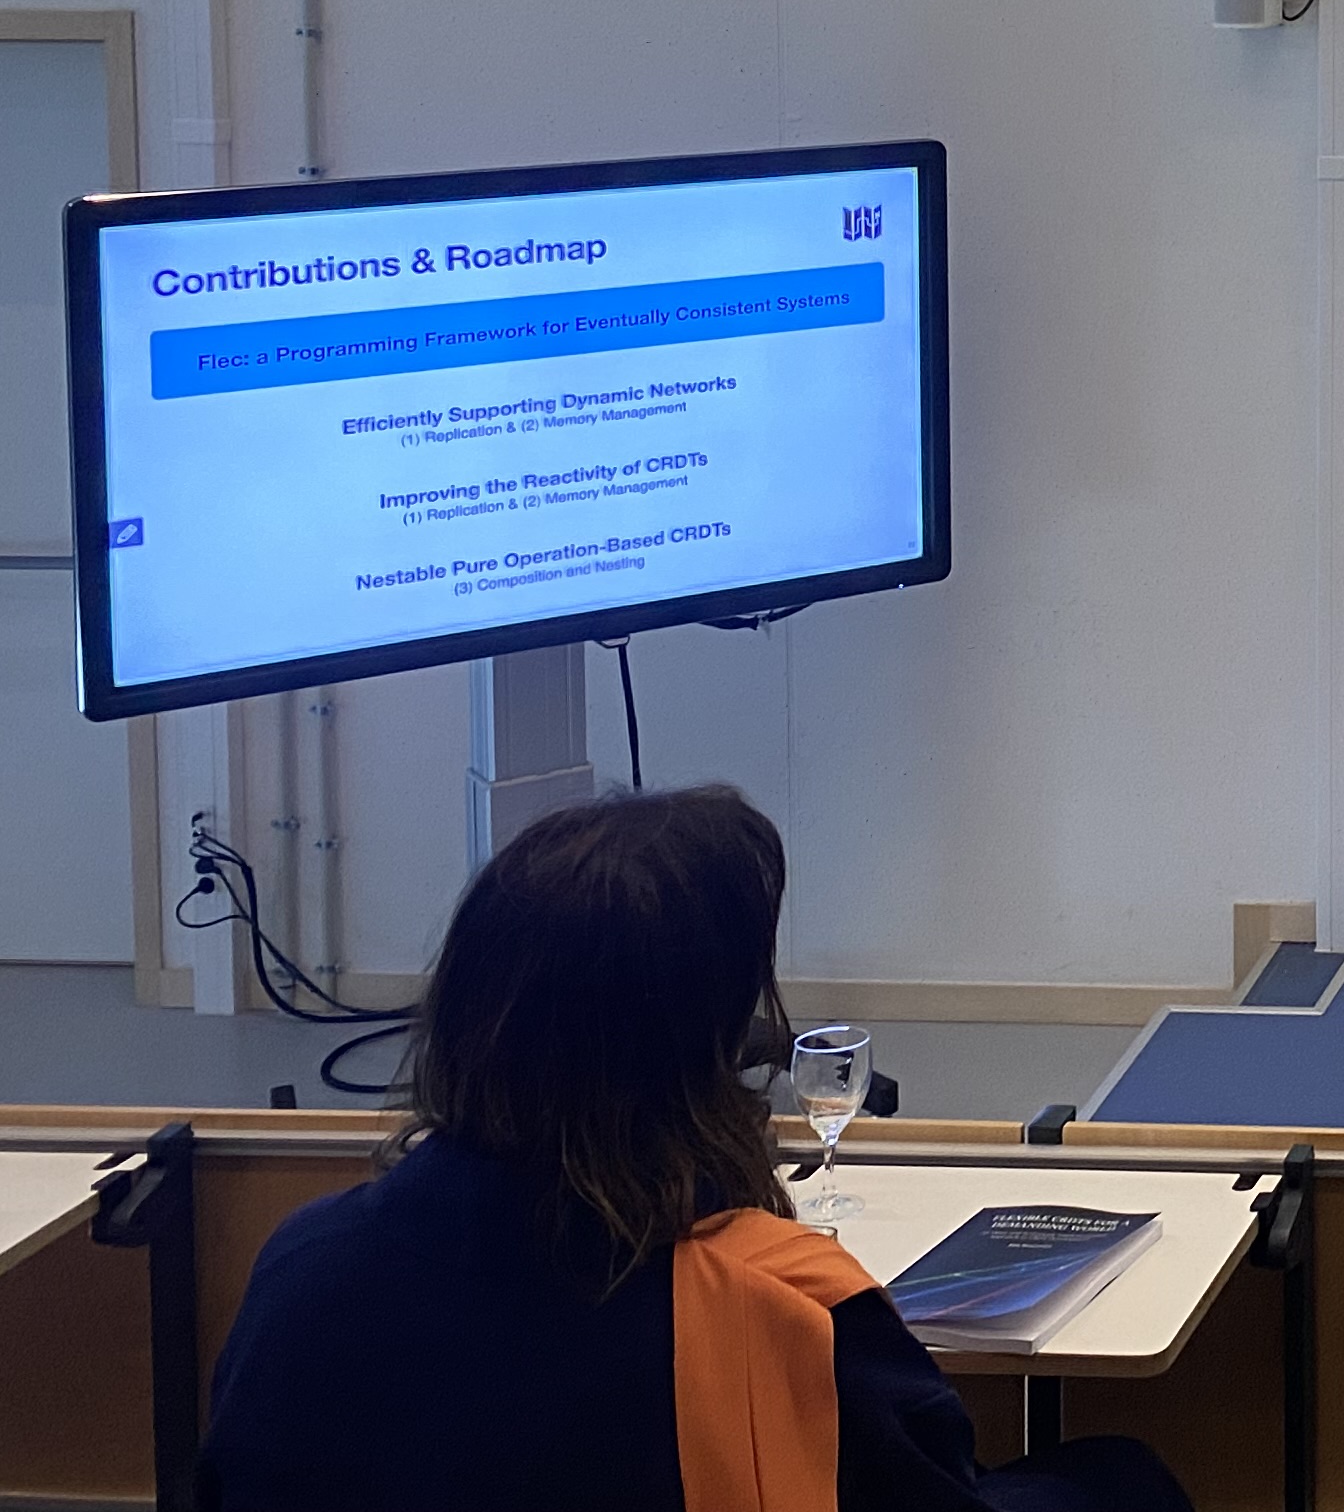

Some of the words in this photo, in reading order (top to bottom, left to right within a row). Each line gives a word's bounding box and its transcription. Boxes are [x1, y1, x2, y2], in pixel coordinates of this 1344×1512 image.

[152, 255, 402, 297] Contributions
[410, 247, 436, 275] &
[444, 237, 608, 272] Roadmap
[198, 352, 249, 371] Flec:
[256, 351, 269, 365] a
[275, 335, 418, 363] Programming
[424, 322, 537, 348] Framework
[542, 319, 569, 336] for
[575, 308, 670, 332] Eventually
[675, 298, 772, 322] Consistent
[776, 291, 850, 312] Systems
[342, 409, 443, 435] Efficiently
[448, 397, 557, 422] Supporting
[562, 386, 644, 411] Dynamic
[649, 376, 737, 399] Networks
[401, 434, 420, 448] (1)
[424, 424, 502, 444] Replication
[506, 421, 517, 434] &
[521, 419, 539, 434] (2)
[543, 413, 598, 428] Memory
[379, 484, 481, 509] Improving
[485, 478, 518, 494] the
[522, 465, 618, 490] Reactivity
[621, 460, 642, 477] of
[646, 451, 709, 473] CRDTs
[403, 512, 422, 527] (1)
[427, 500, 504, 521] Replication
[508, 498, 518, 510] &
[523, 495, 541, 511] (2)
[545, 488, 600, 505] Memory
[355, 564, 447, 591] Nestable
[452, 558, 498, 576] Pure
[503, 531, 665, 570] Operation-Based
[670, 521, 732, 543] CRDTs
[454, 581, 473, 597] (3)
[477, 566, 562, 591] Composition
[566, 562, 592, 578] and
[595, 556, 646, 571] Nesting
